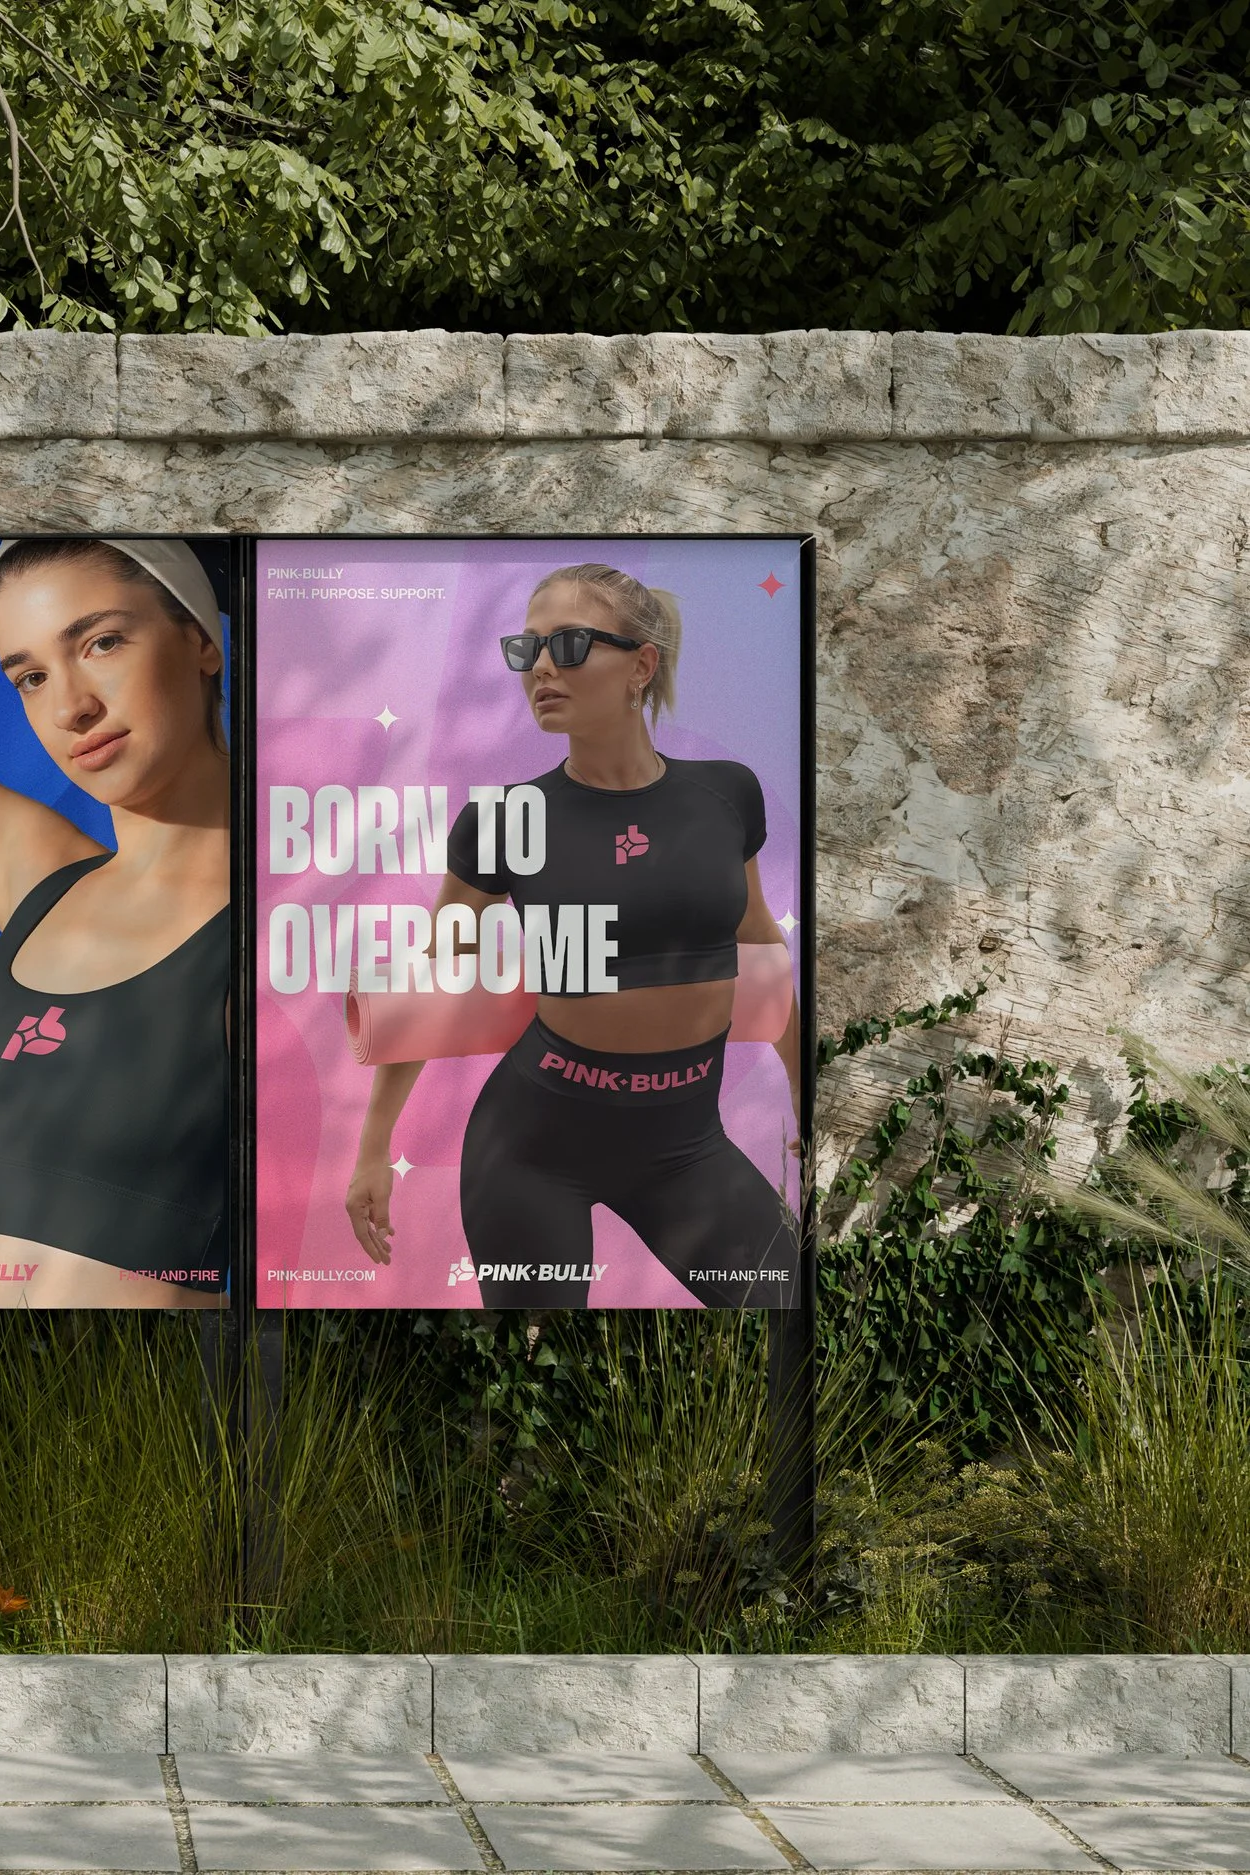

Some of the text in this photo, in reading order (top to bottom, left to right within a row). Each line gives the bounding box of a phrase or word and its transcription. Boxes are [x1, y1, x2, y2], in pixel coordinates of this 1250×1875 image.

[268, 568, 344, 579] PINK-BULLY
[268, 588, 446, 600] FAITH. PURPOSE. SUPPORT.
[268, 785, 547, 875] BORN TO
[268, 903, 619, 994] OVERCOME
[120, 1270, 220, 1281] FAITH AND FIRE
[268, 1269, 376, 1281] PINK-BULLY.COM
[690, 1270, 788, 1281] FAITH AND FIRE
